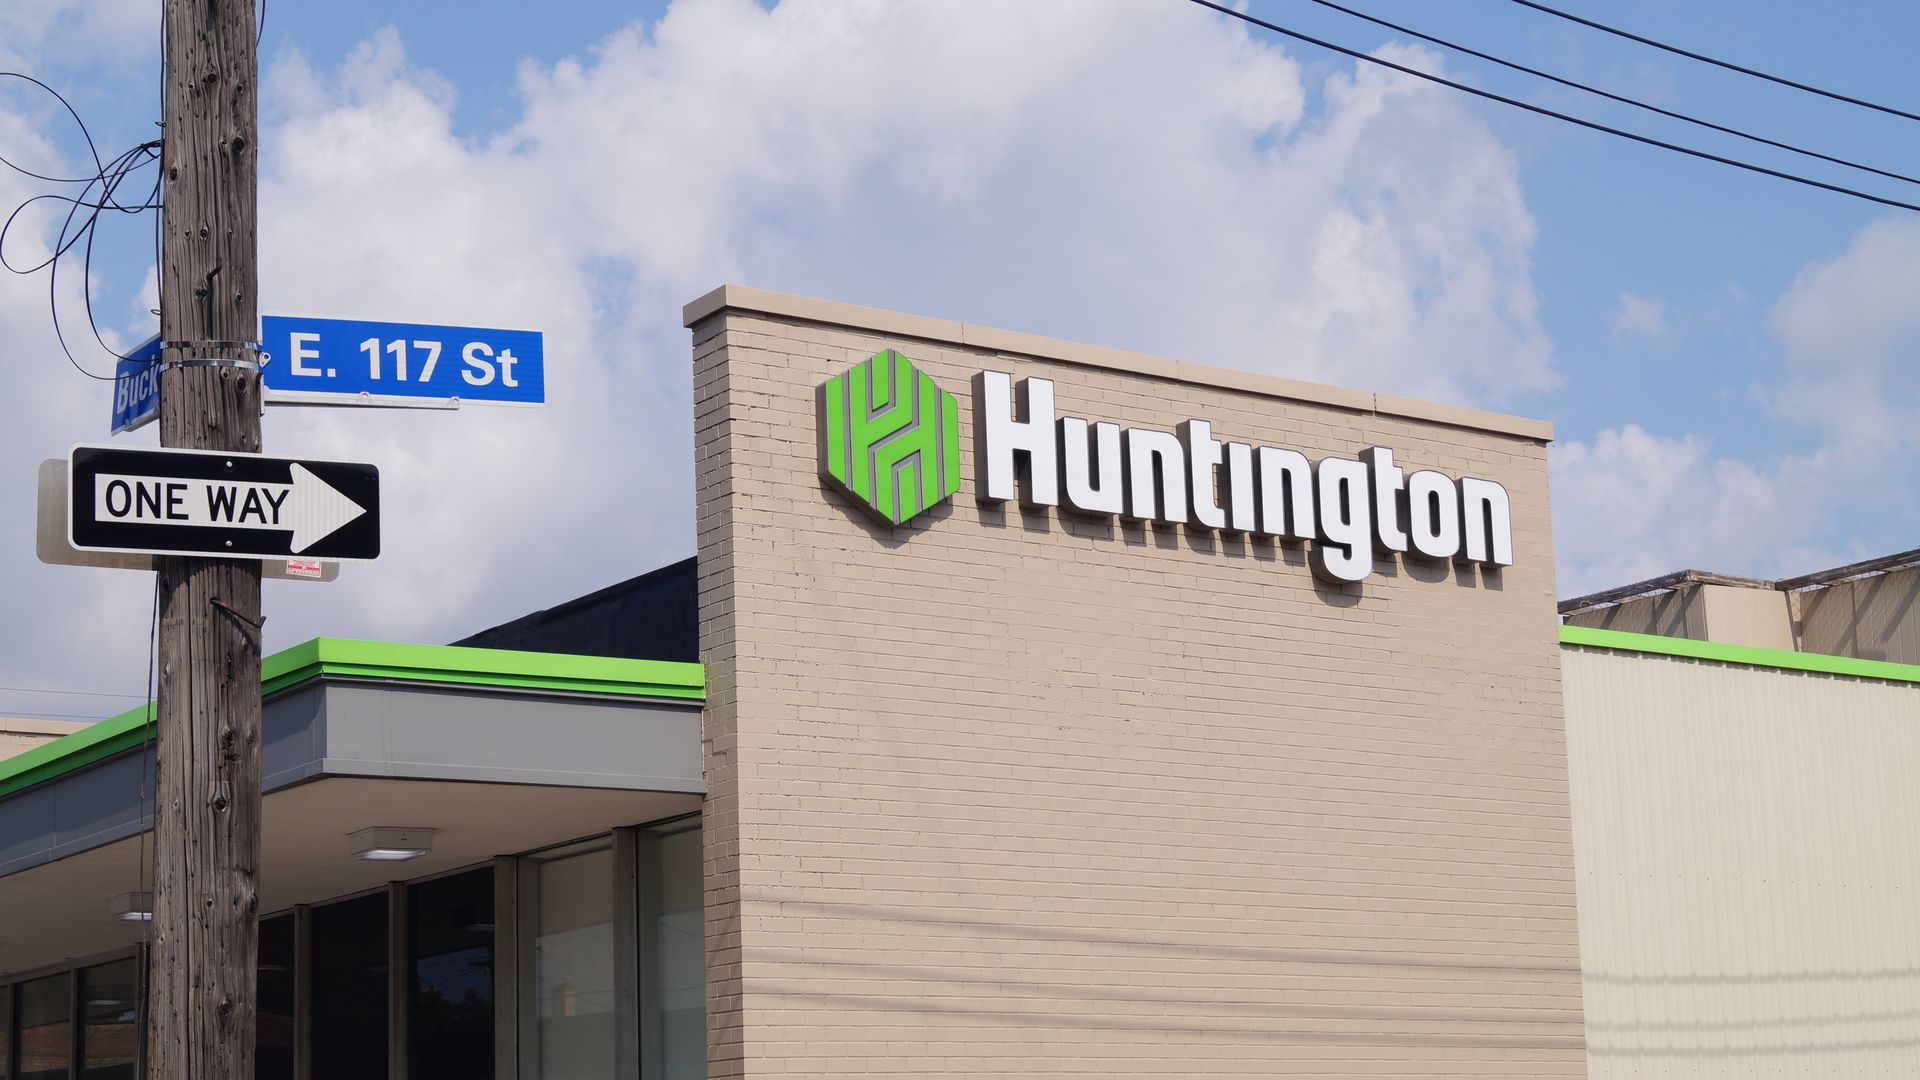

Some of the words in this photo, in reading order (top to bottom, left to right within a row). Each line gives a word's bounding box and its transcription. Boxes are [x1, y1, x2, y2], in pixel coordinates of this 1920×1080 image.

[290, 332, 337, 378] E.
[360, 337, 442, 383] 117
[461, 342, 519, 387] St
[105, 479, 189, 521] ONE
[206, 485, 290, 525] WAY
[980, 370, 1513, 583] Huntington
